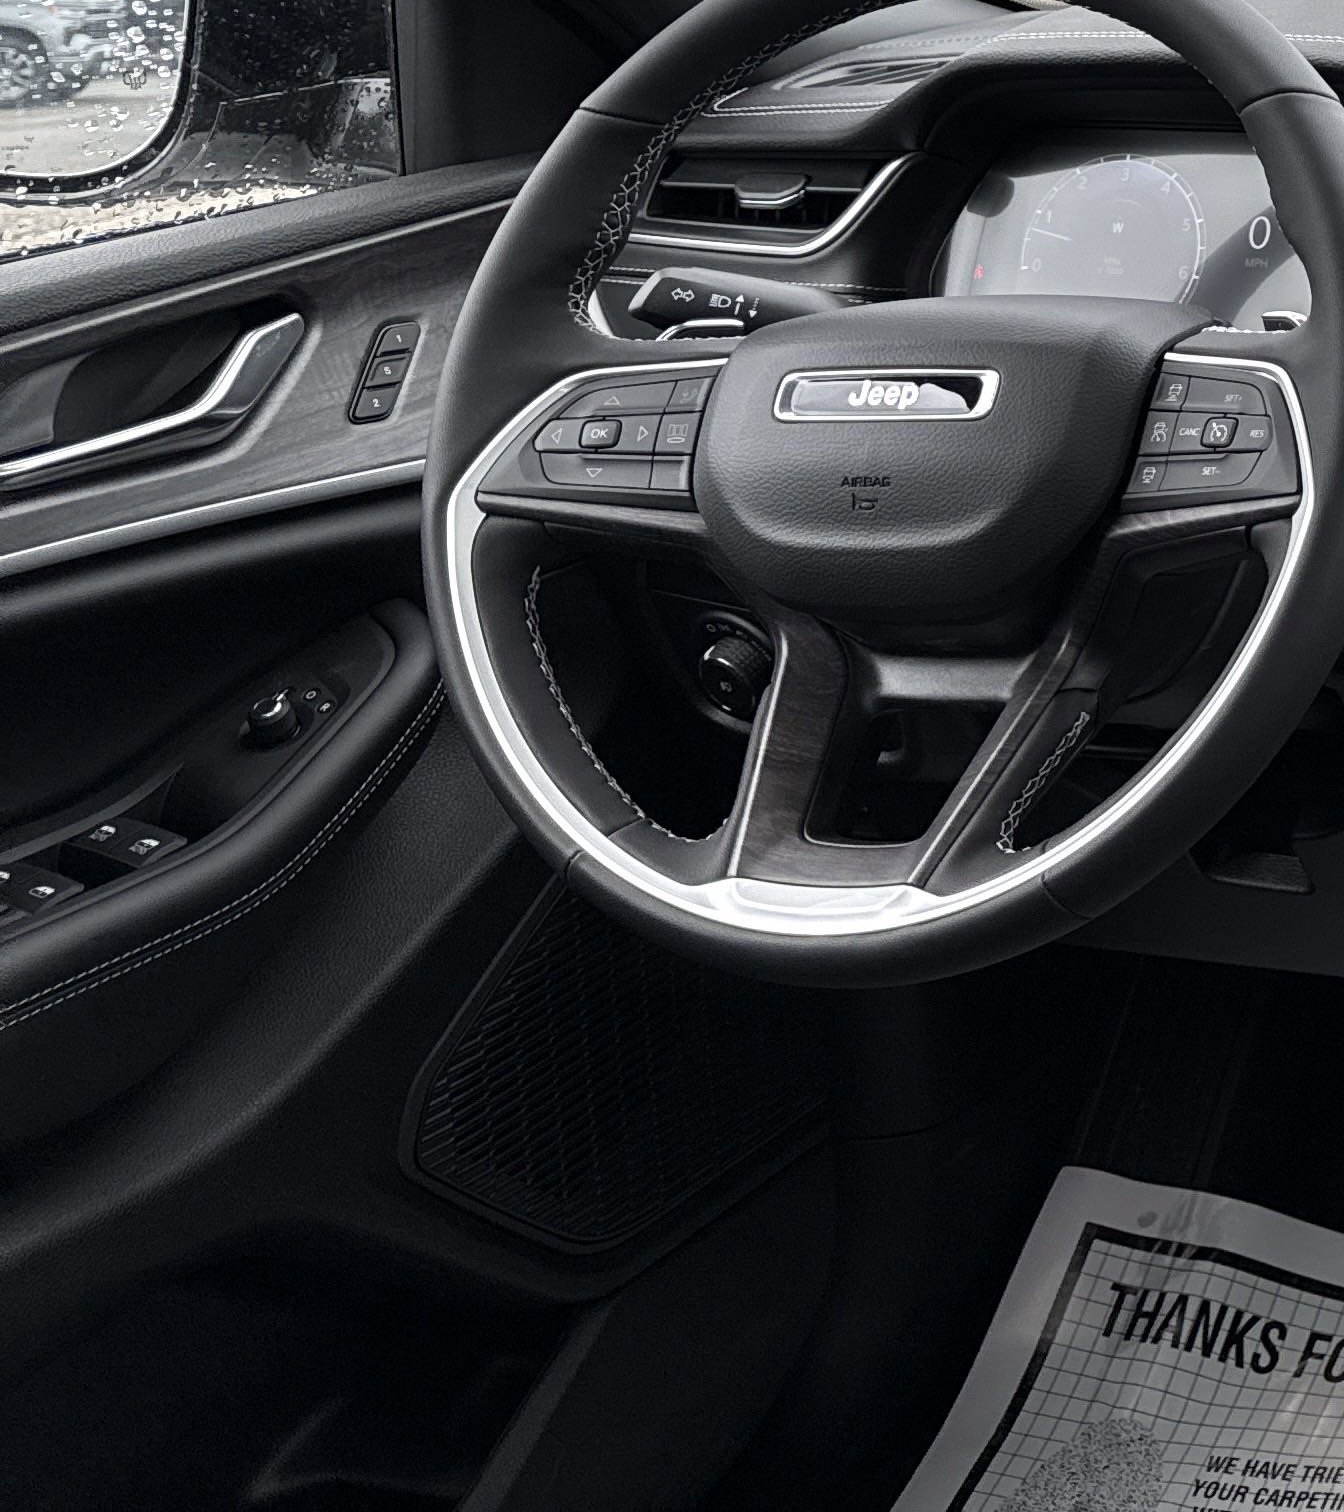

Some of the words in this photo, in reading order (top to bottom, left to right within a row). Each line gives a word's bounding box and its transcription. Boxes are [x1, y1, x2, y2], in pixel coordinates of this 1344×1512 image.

[1248, 215, 1270, 250] 0
[1245, 257, 1269, 268] MPH
[848, 379, 920, 410] Jeep
[372, 398, 380, 407] 2
[590, 428, 609, 439] OK
[1179, 427, 1201, 436] CANC
[1250, 429, 1265, 438] RES
[840, 476, 891, 489] AIRBAG
[1102, 1282, 1288, 1375] THANKS
[1206, 1454, 1240, 1475] WE
[1242, 1459, 1298, 1481] HAVE
[1192, 1478, 1248, 1506] YOUR
